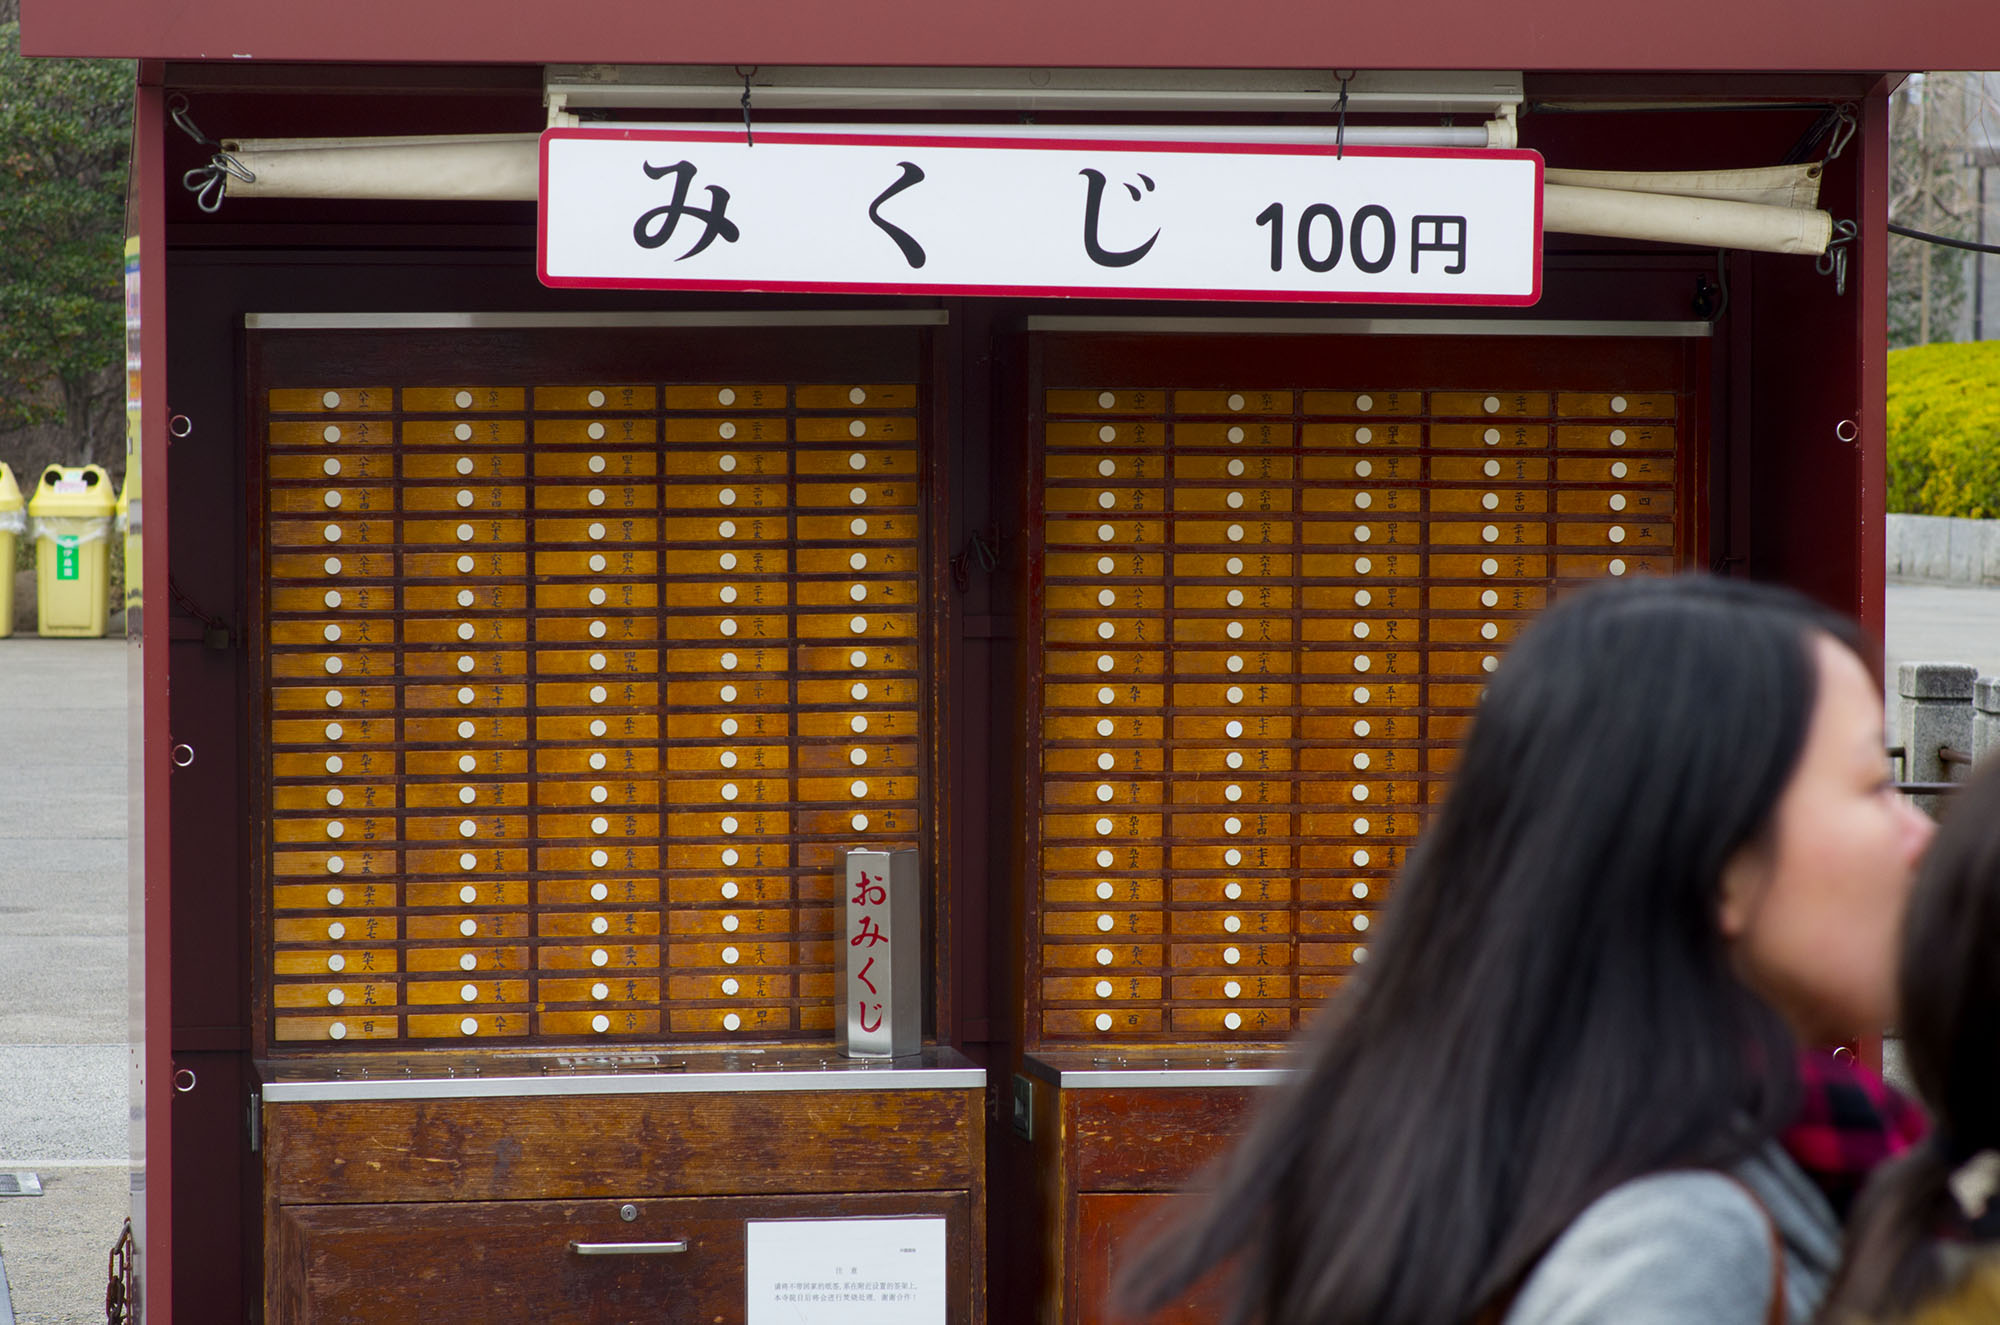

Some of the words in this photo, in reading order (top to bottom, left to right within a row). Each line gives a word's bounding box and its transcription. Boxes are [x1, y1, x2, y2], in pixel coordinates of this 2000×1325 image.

[634, 161, 1160, 268] みくじ
[1256, 203, 1466, 274] 100円
[359, 390, 369, 408] 八十一
[359, 423, 368, 443] 八十二
[883, 424, 894, 432] 二
[1515, 428, 1527, 445] 二十二
[1640, 430, 1652, 439] 二
[883, 457, 893, 465] 三
[1133, 457, 1144, 477] 八十三
[1639, 464, 1651, 472] 三
[359, 489, 370, 509] 八十四
[624, 488, 634, 507] 四十四
[753, 487, 763, 506] 二十四
[1133, 490, 1145, 509] 八十四
[1260, 490, 1271, 510] 六十四
[1388, 491, 1397, 509] 四十四
[1515, 492, 1524, 511] 二十四
[1639, 497, 1651, 506] 四
[491, 521, 501, 541] 六十五
[622, 521, 633, 540] 四十五
[753, 520, 763, 539] 二十五
[884, 520, 894, 530] 五
[1134, 522, 1144, 542] 八十五
[1261, 523, 1272, 542] 六十五
[1513, 524, 1524, 543] 二十五
[1640, 528, 1652, 537] 五
[359, 555, 370, 575] 八十六
[491, 554, 502, 575] 六十六
[754, 553, 763, 572] 二十六
[884, 554, 894, 564] 六
[1133, 555, 1144, 574] 八十六
[1260, 555, 1270, 575] 六十六
[1387, 556, 1397, 575] 四十六
[1514, 556, 1524, 576] 二十六
[358, 589, 368, 608] 八十七
[491, 587, 502, 608] 六十七
[622, 586, 632, 605] 四十七
[754, 585, 764, 604] 二十七
[883, 586, 893, 595] 七
[1134, 587, 1144, 607] 八十七
[1260, 588, 1270, 607] 六十七
[1387, 588, 1397, 607] 四十七
[1513, 589, 1523, 608] 二十七
[358, 621, 371, 641] 八十八
[754, 618, 766, 636] 二十八
[883, 621, 895, 630] 八
[1135, 620, 1145, 640] 八十八
[1259, 620, 1271, 640] 六十八
[1386, 621, 1398, 640] 四十八
[360, 654, 370, 674] 八十九
[493, 654, 502, 673] 六十九
[624, 652, 638, 671] 四十九
[884, 653, 894, 664] 九
[1133, 653, 1144, 673] 八十九
[1259, 653, 1269, 672] 六十九
[1385, 654, 1396, 673] 四十九
[360, 688, 369, 708] 九十
[492, 686, 504, 704] 七十
[624, 684, 635, 702] 五十
[884, 684, 894, 696] 十
[1130, 686, 1140, 702] 九十
[1258, 686, 1268, 702] 七十
[1386, 686, 1396, 703] 五十
[360, 720, 371, 739] 九十一
[884, 713, 894, 728] 十一
[1133, 718, 1142, 736] 九十一
[1258, 718, 1268, 736] 七十一
[1385, 718, 1395, 736] 五十一
[360, 753, 372, 773] 九十二
[755, 748, 765, 767] 三十二
[882, 746, 893, 762] 十二
[1133, 750, 1143, 770] 九十二
[1258, 750, 1269, 769] 七十二
[1384, 750, 1395, 770] 五十二
[365, 787, 376, 807] 九十三
[1257, 782, 1269, 802] 七十三
[1384, 783, 1395, 801] 五十三
[364, 819, 376, 839] 九十四
[493, 818, 505, 837] 七十四
[754, 814, 765, 833] 三十四
[884, 811, 896, 828] 十四
[1129, 815, 1138, 835] 九十四
[1257, 815, 1268, 835] 七十四
[1385, 815, 1395, 834] 五十四
[361, 853, 373, 873] 九十五
[494, 850, 504, 871] 七十五
[1129, 848, 1139, 868] 九十五
[1257, 848, 1268, 866] 七十五
[364, 885, 376, 905] 九十六
[494, 883, 504, 903] 七十六
[1130, 881, 1140, 900] 九十六
[366, 918, 378, 939] 九十七
[492, 916, 504, 935] 七十七
[755, 911, 765, 931] 三十七
[1129, 914, 1139, 932] 九十七
[493, 948, 505, 969] 七十八
[755, 944, 766, 964] 三十八
[851, 871, 888, 1032] おみくじ
[1132, 946, 1142, 965] 九十八
[1257, 945, 1269, 965] 七十八
[363, 952, 374, 971] 九十八
[365, 985, 376, 1005] 九十九
[757, 976, 766, 996] 三十九
[1130, 978, 1140, 998] 九十九
[1257, 977, 1267, 997] 七十九
[363, 1021, 375, 1032] 百
[496, 1016, 506, 1032] 八十
[626, 1012, 636, 1029] 六十
[757, 1010, 767, 1025] 四十
[1128, 1015, 1139, 1024] 百
[1257, 1010, 1268, 1026] 八十
